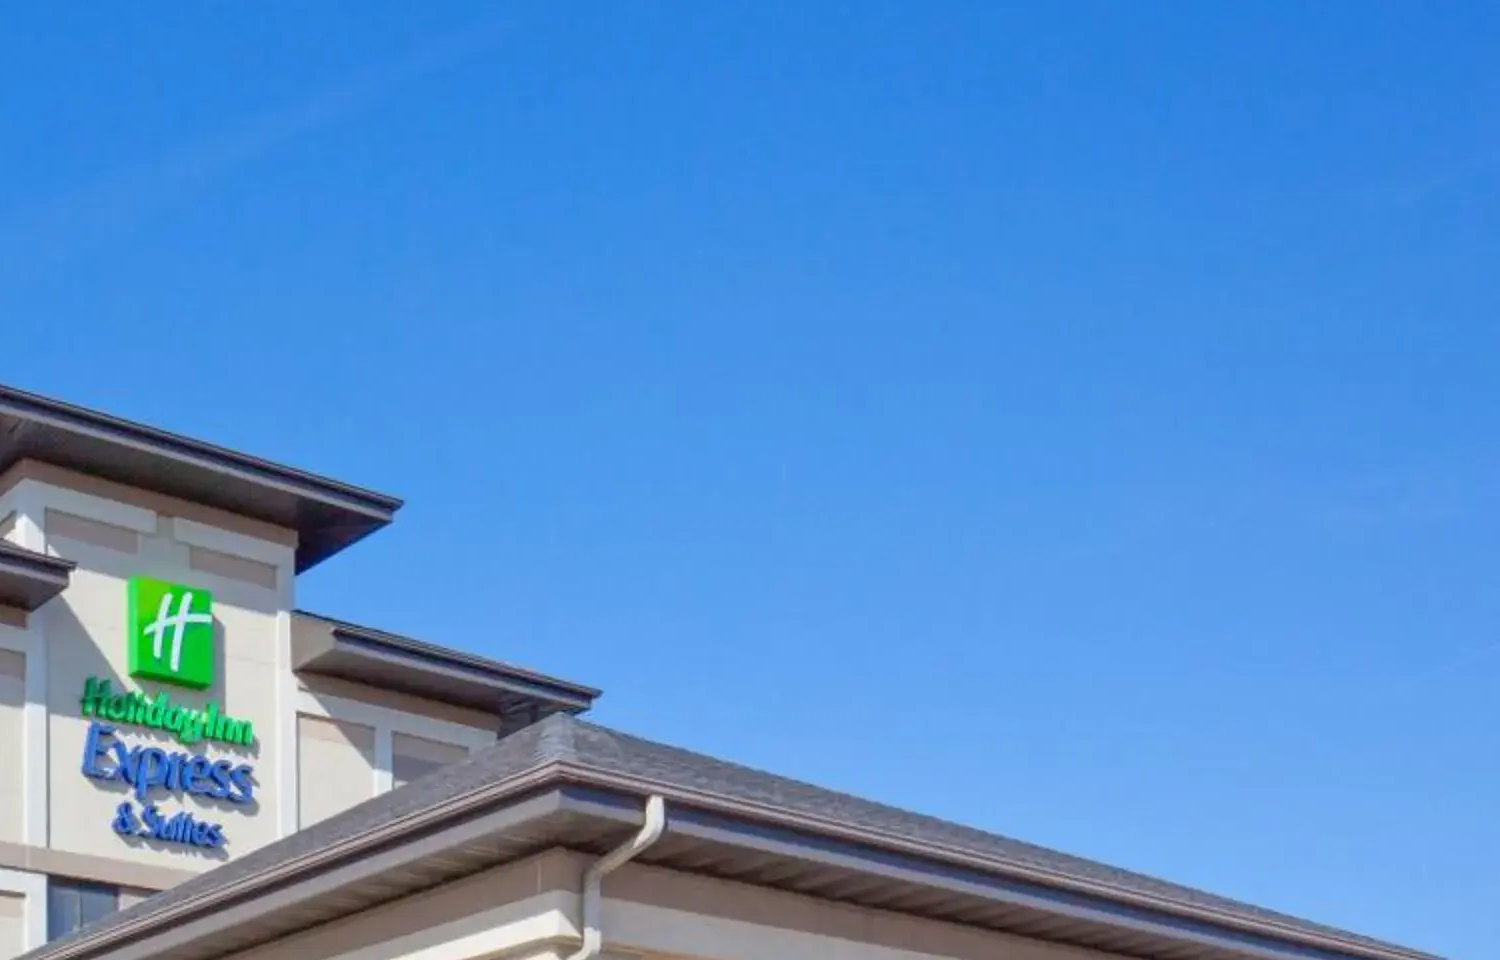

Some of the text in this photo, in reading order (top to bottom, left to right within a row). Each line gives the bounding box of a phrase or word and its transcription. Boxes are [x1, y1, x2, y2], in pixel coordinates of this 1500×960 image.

[81, 676, 254, 745] Holiday Inn
[81, 721, 254, 804] Express
[112, 801, 226, 848] & Suites
